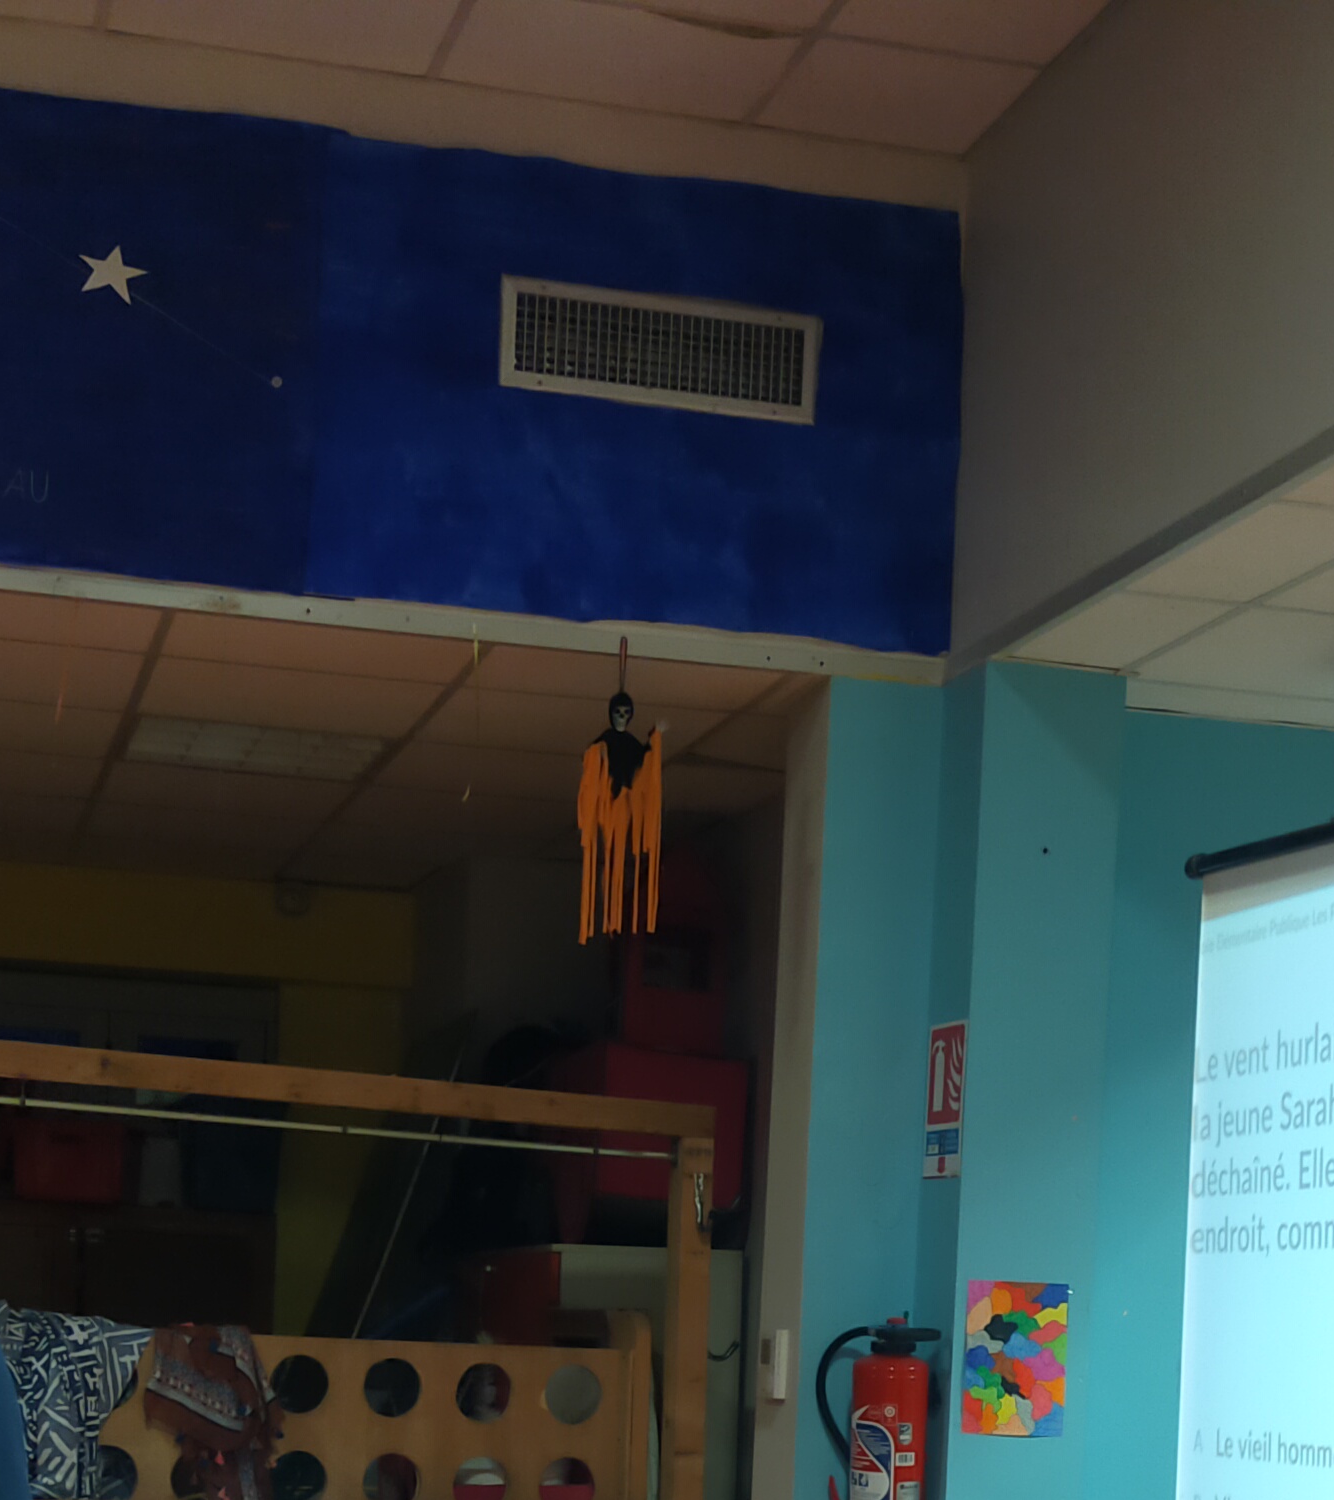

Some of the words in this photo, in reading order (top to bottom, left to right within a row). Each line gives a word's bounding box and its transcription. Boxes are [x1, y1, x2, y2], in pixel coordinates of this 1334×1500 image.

[1312, 909, 1328, 927] Les
[1196, 1048, 1218, 1083] Le
[1225, 1038, 1269, 1077] vent
[1192, 1100, 1211, 1141] la
[1215, 1103, 1273, 1148] jeune
[1191, 1155, 1290, 1200] déchaîné.
[1190, 1214, 1269, 1257] endroit,
[1216, 1428, 1233, 1458] Le
[1238, 1430, 1271, 1463] vieil
